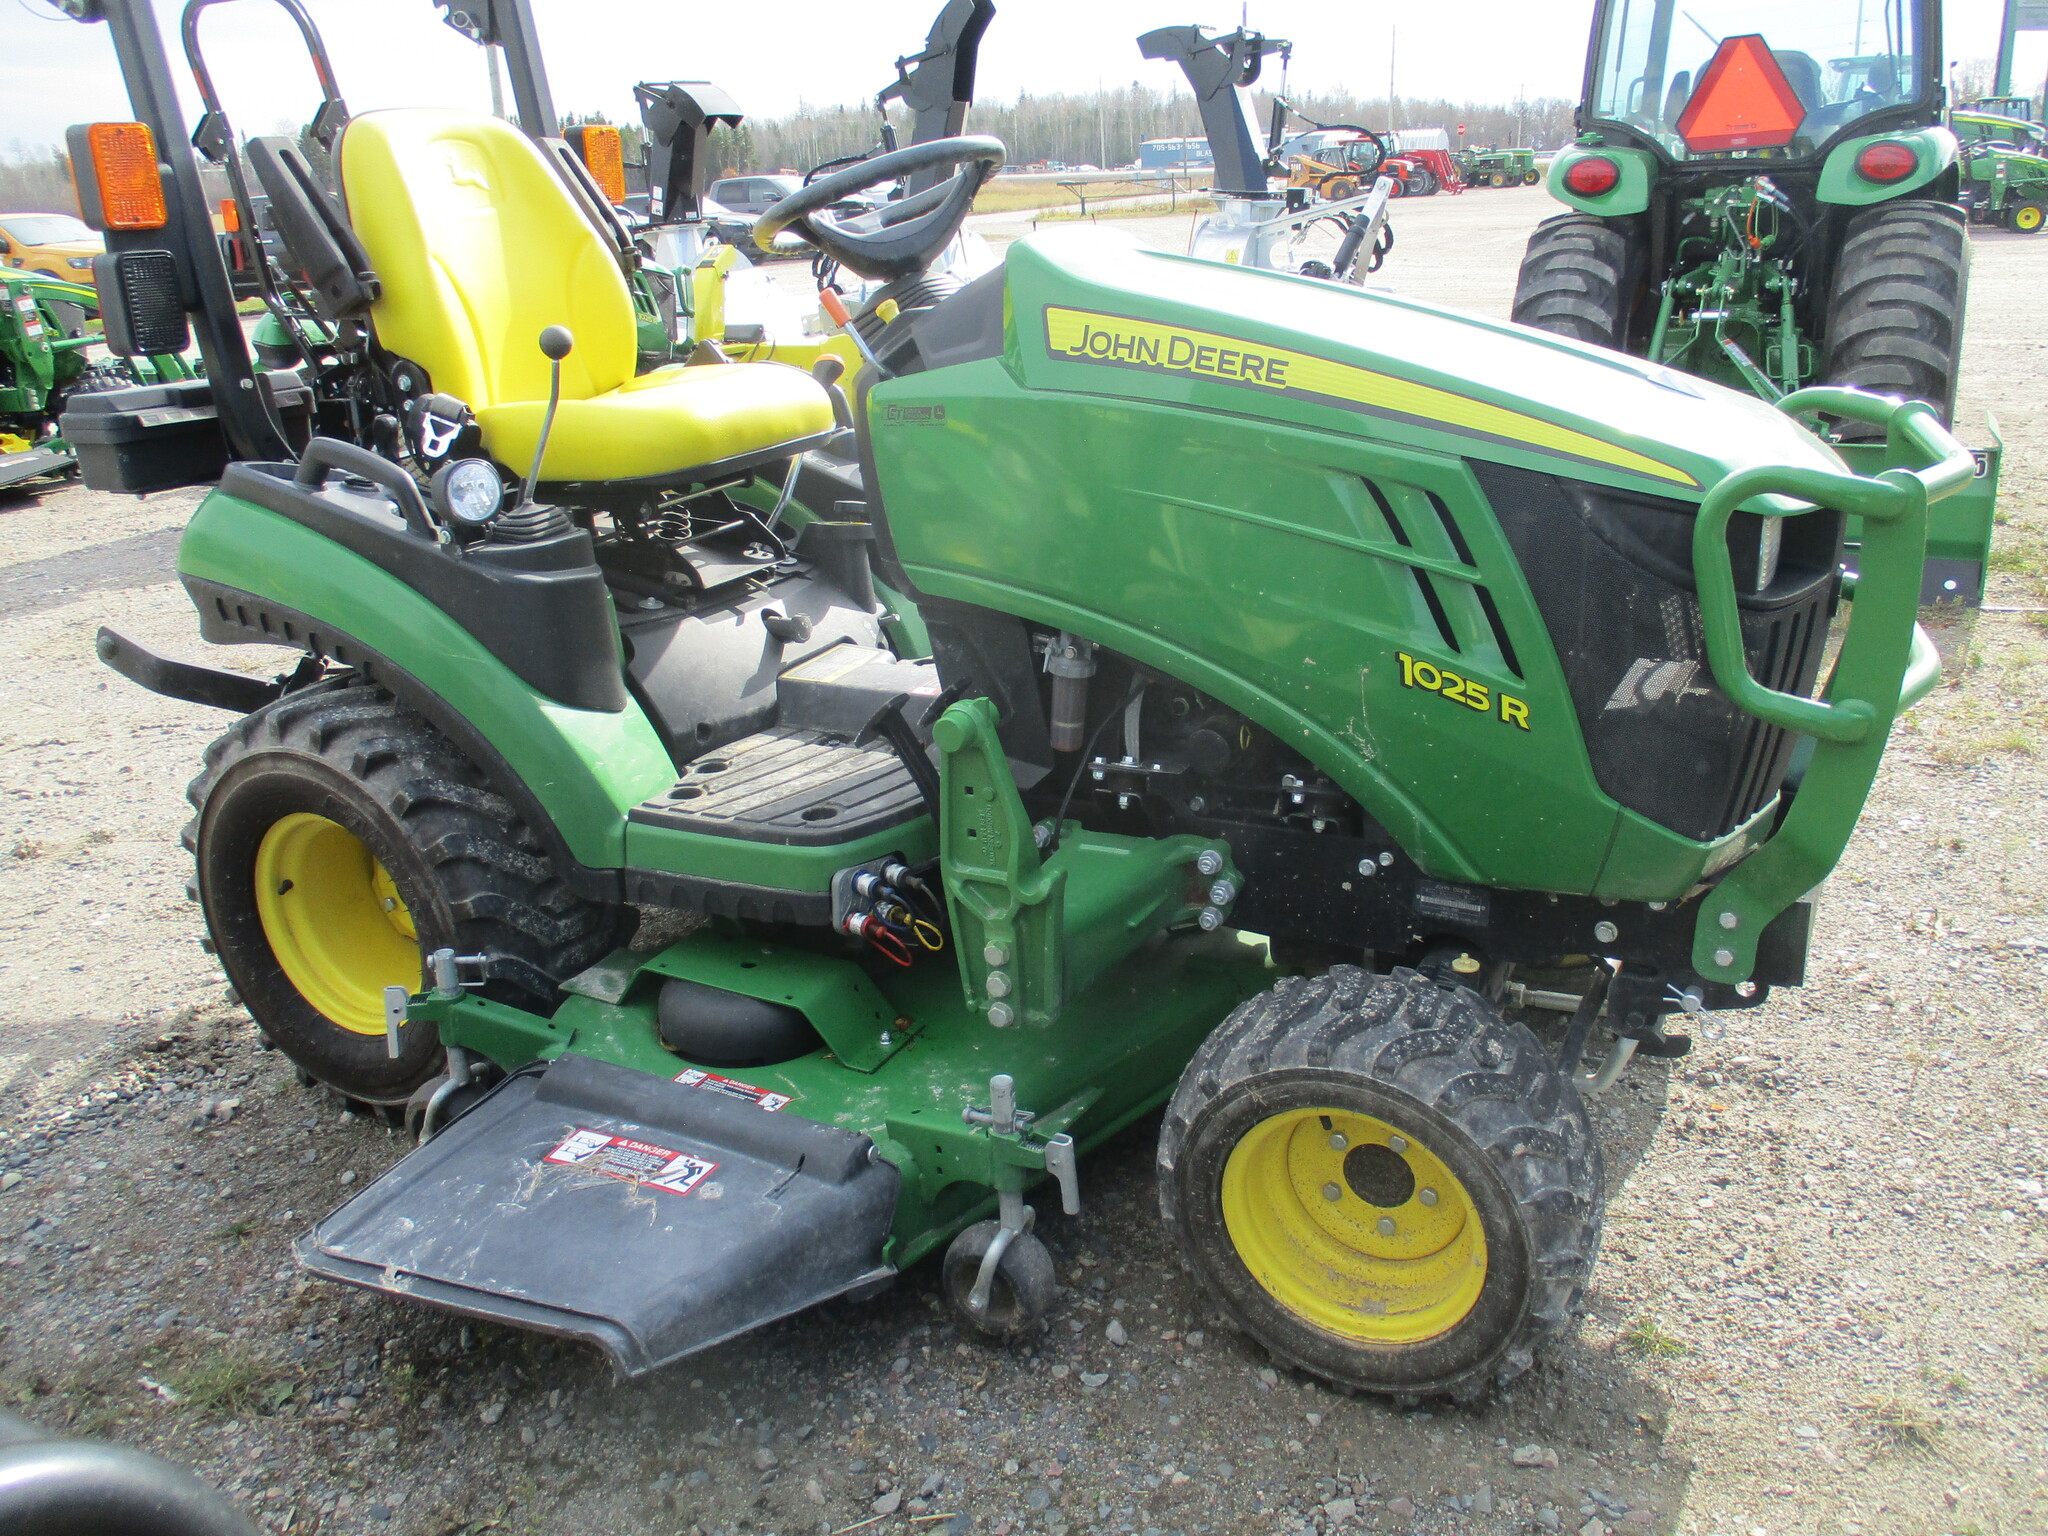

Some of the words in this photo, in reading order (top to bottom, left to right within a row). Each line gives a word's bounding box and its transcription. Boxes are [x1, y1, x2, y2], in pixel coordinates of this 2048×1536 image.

[1152, 142, 1201, 152] 705-563-656
[1070, 324, 1161, 363] JOHN
[1167, 335, 1290, 386] DEERE
[1395, 651, 1491, 712] 1025
[1498, 692, 1531, 732] R
[728, 1079, 757, 1090] DANGER
[628, 1141, 674, 1157] DANGER
